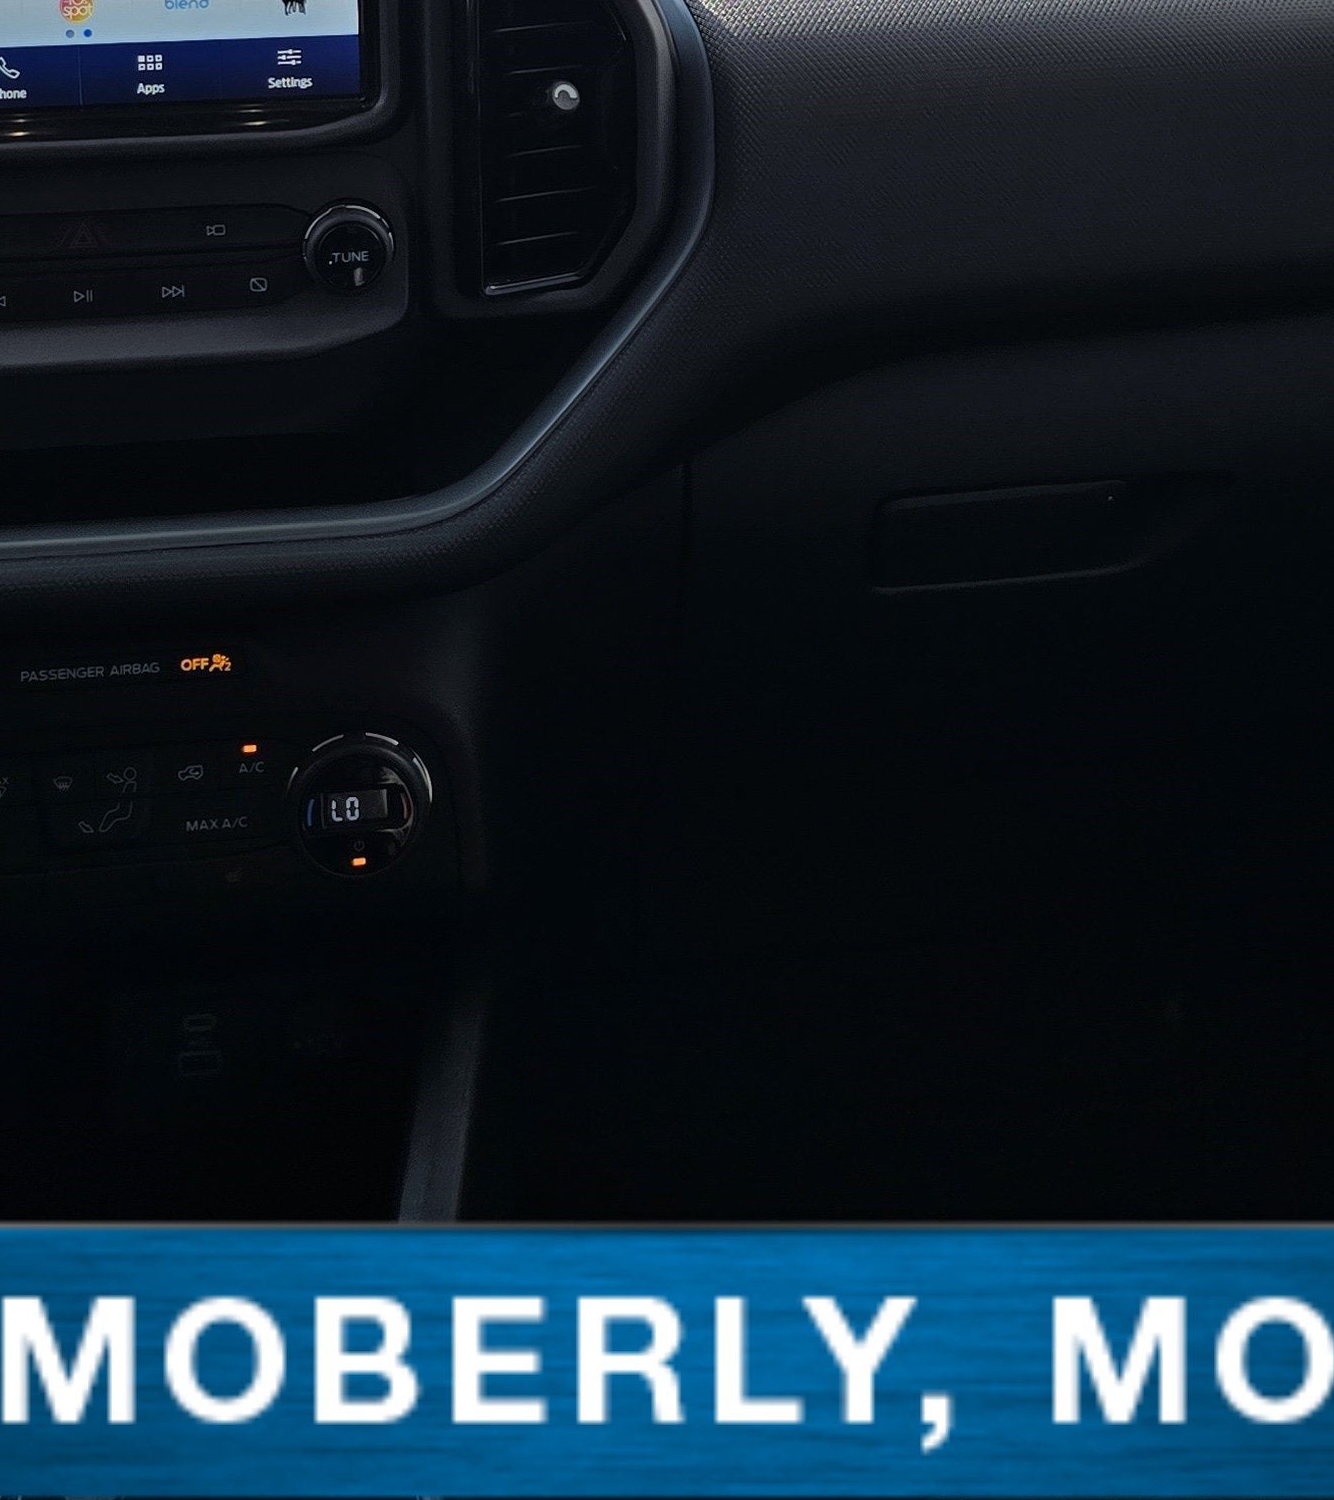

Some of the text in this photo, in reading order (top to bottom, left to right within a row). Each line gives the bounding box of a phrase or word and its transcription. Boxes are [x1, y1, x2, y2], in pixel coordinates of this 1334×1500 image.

[63, 3, 93, 20] spot
[137, 82, 165, 95] Apps
[267, 76, 313, 89] Settings
[331, 250, 369, 263] TUNE
[180, 657, 209, 672] OFF
[20, 662, 161, 682] PASSENGER AIRBAG
[239, 761, 266, 773] A/C
[185, 816, 249, 832] MAX A/C
